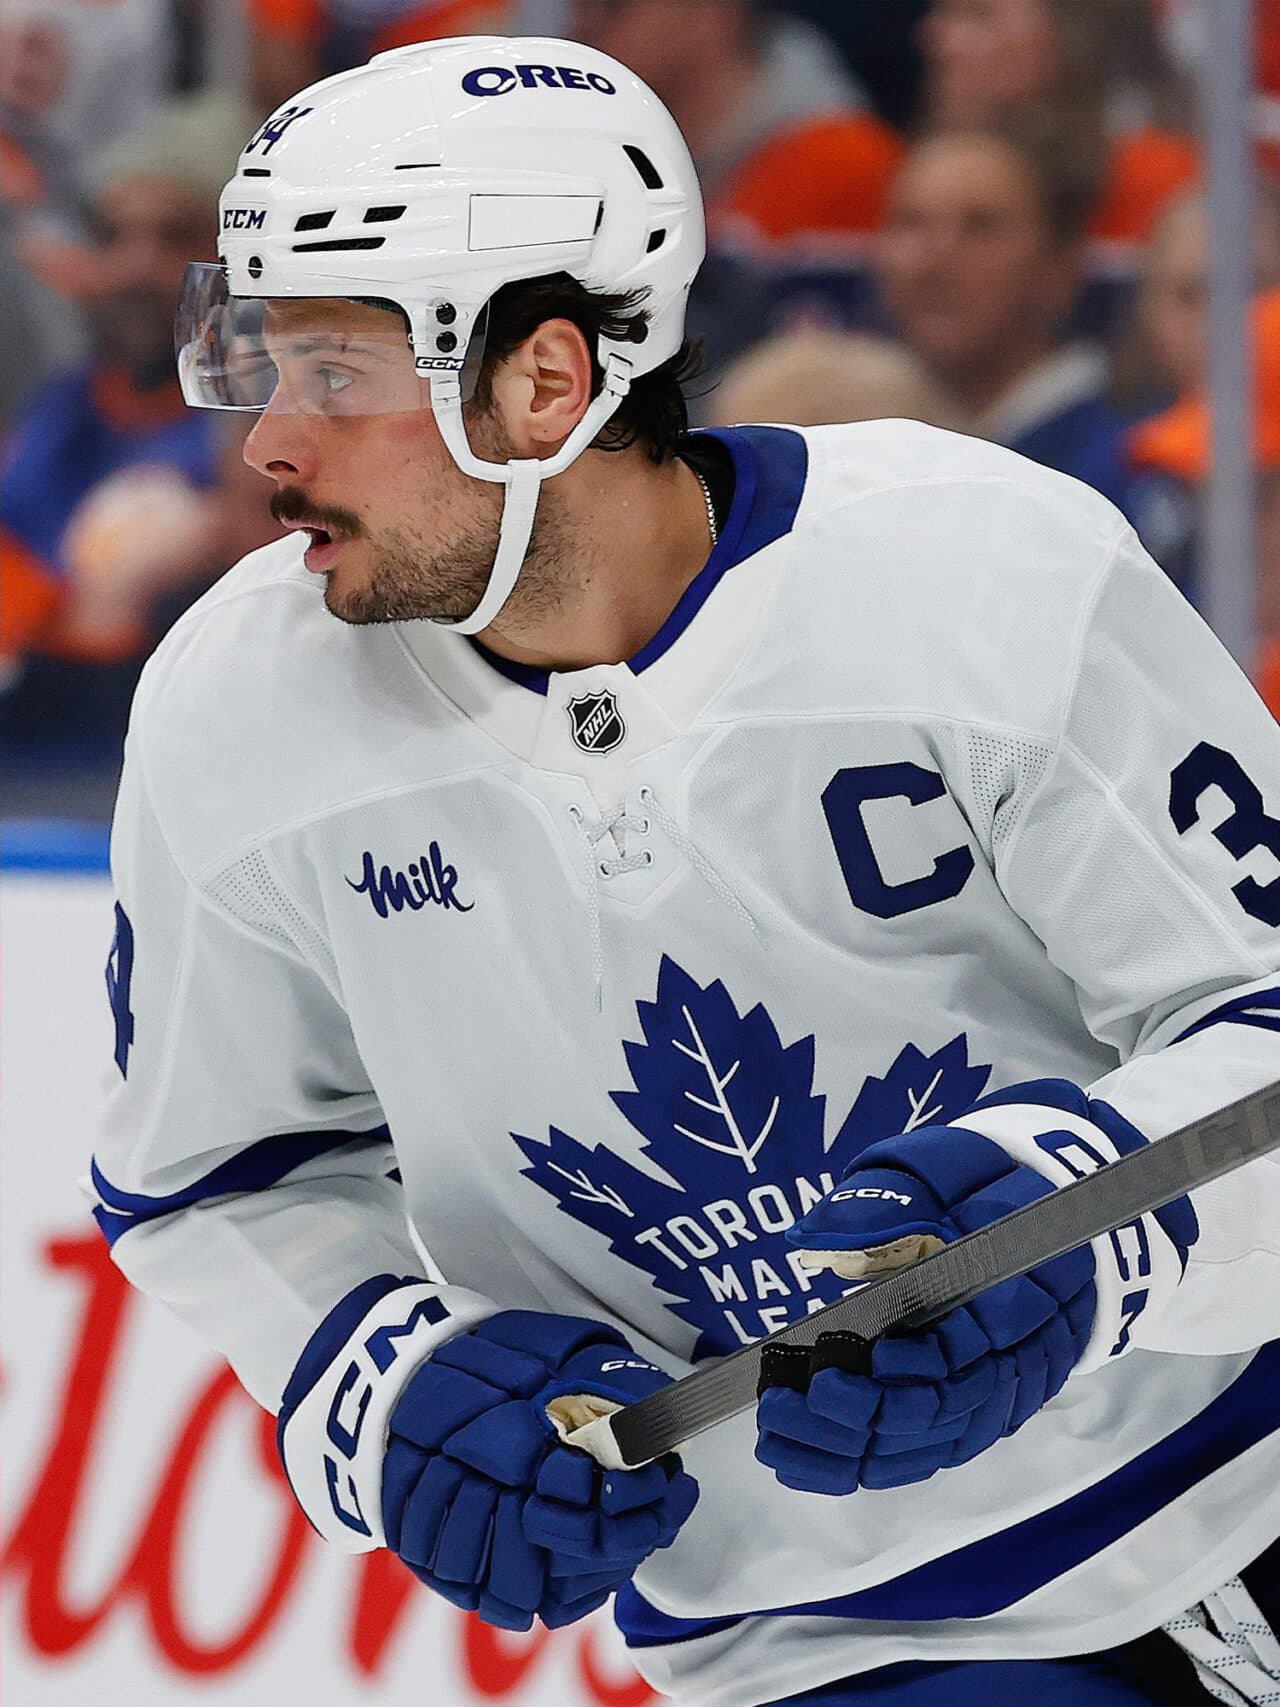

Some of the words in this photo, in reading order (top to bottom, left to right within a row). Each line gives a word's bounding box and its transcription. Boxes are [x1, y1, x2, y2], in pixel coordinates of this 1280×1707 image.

[462, 64, 616, 96] OREO
[223, 209, 267, 229] CCM
[417, 358, 464, 369] CCM
[821, 761, 975, 919] C
[830, 1188, 912, 1206] CCM
[326, 1296, 452, 1538] CCM
